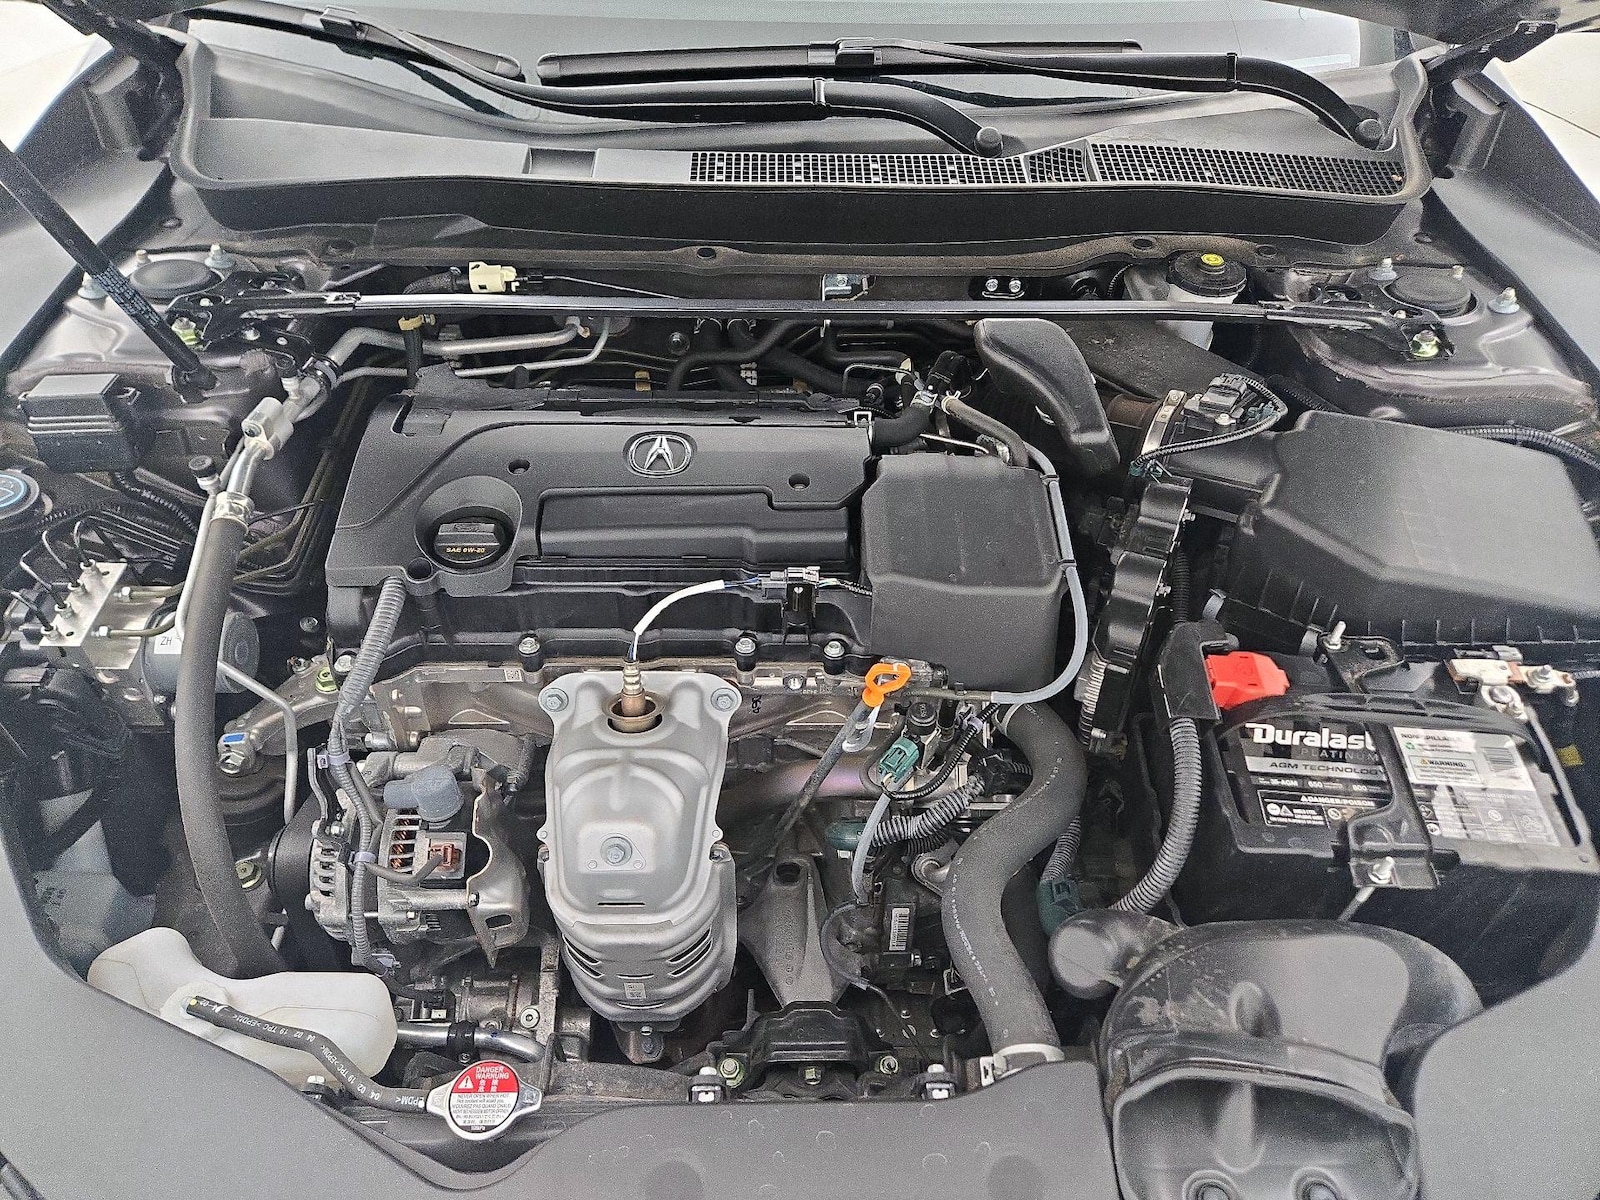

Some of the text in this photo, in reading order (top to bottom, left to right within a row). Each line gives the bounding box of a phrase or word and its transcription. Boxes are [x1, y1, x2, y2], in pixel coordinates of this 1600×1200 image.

[160, 636, 172, 646] ZH
[1300, 748, 1380, 762] PLATINUM
[1269, 761, 1299, 769] AGM
